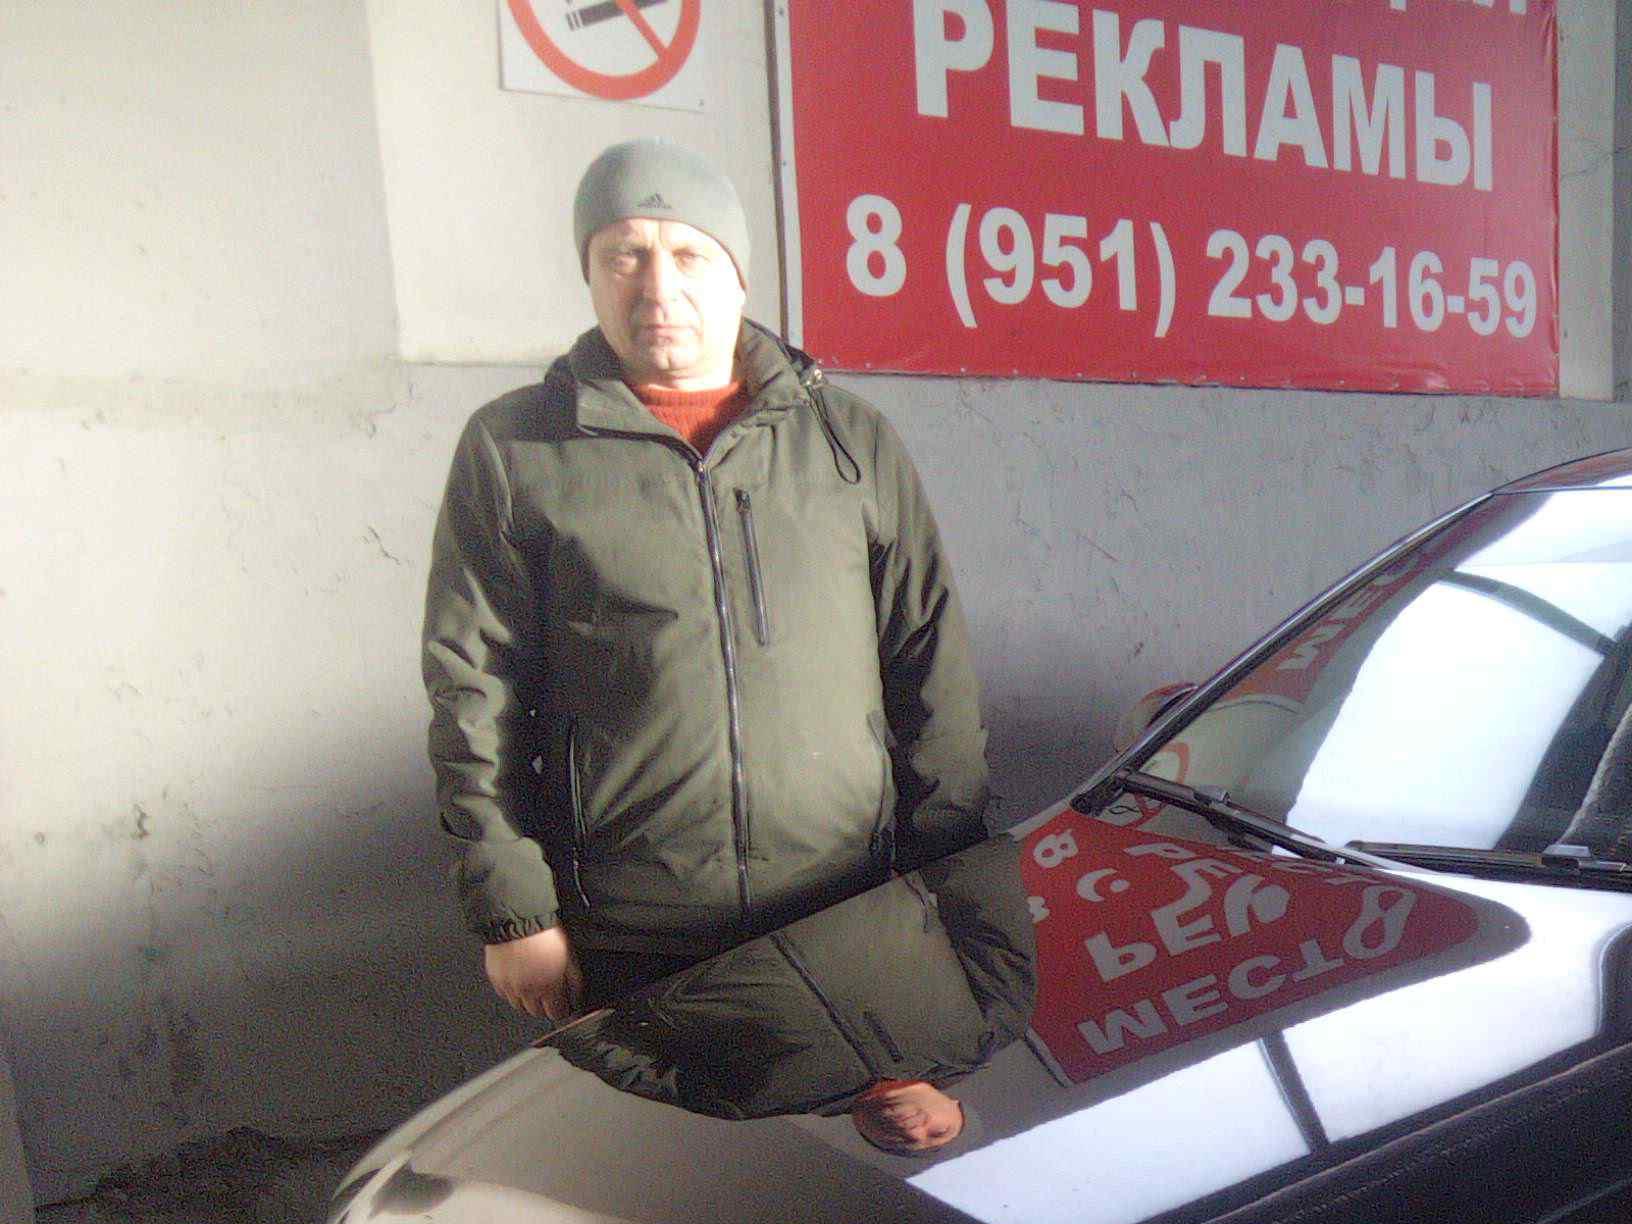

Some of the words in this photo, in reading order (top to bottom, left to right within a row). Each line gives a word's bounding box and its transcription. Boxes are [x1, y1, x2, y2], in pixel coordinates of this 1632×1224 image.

[913, 0, 1494, 191] РЕКЛАМЫ
[845, 194, 907, 297] 8
[945, 203, 1177, 338] (951)
[1206, 230, 1537, 339] 233-16-59
